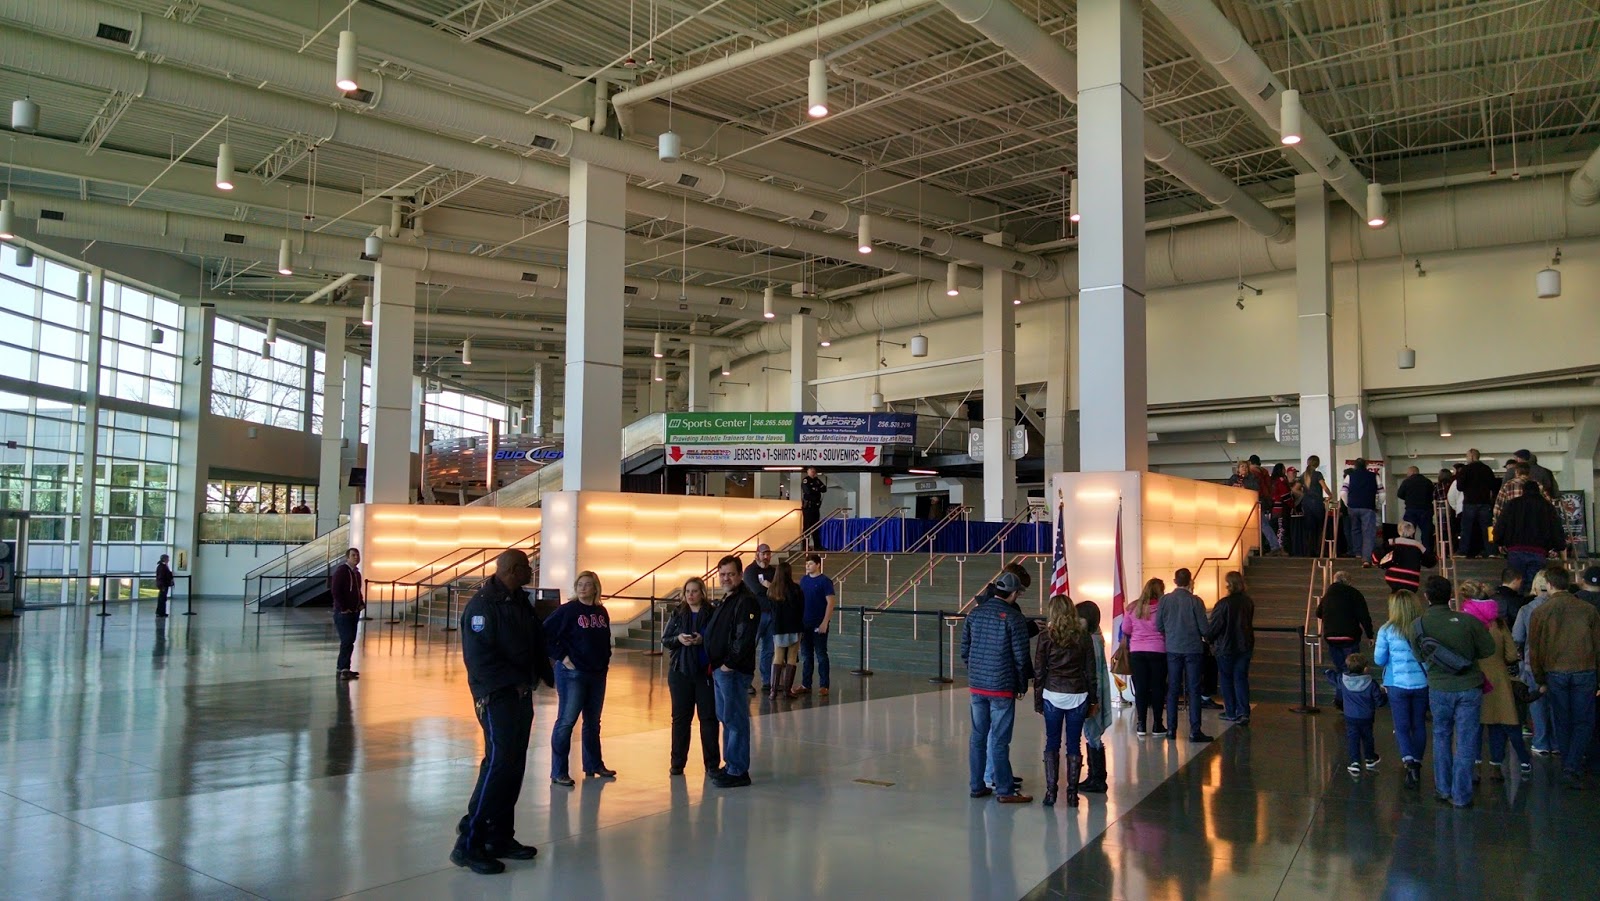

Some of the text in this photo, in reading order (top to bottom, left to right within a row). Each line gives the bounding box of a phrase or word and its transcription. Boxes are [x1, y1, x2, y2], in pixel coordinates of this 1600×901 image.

[682, 418, 712, 430] Sports
[714, 418, 746, 428] Center
[802, 415, 828, 426] TOC
[494, 450, 526, 459] BUD
[734, 448, 860, 461] JERSEYS T-SHIRTS HATS SOUVENIRS
